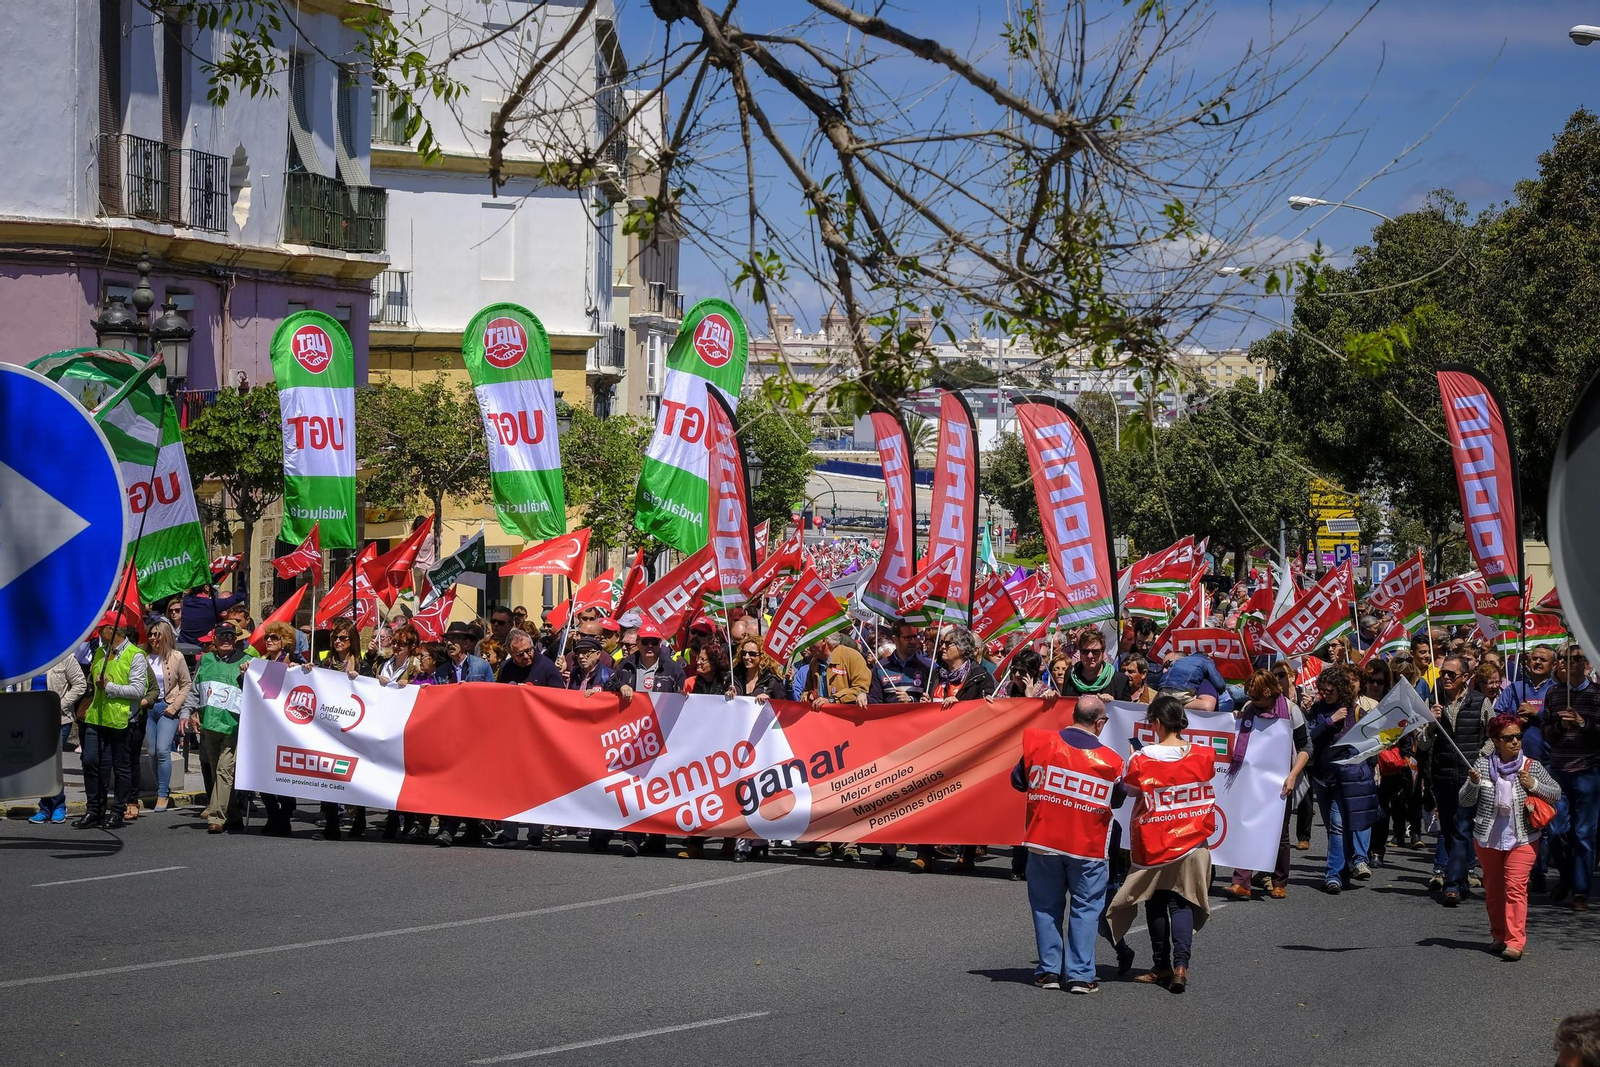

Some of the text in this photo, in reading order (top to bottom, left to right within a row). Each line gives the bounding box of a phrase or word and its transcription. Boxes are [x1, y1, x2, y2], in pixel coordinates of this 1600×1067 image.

[1336, 545, 1348, 562] P
[1379, 563, 1389, 581] P
[291, 691, 315, 709] UGT
[320, 703, 356, 718] Andalucía
[600, 715, 653, 748] mayo
[279, 750, 332, 774] CCOO
[605, 732, 660, 773] 2018
[275, 776, 291, 784] unión
[292, 778, 320, 789] provincial
[329, 781, 346, 791] Cádiz
[605, 740, 757, 818] Tiempo
[675, 740, 850, 832] de ganar
[830, 763, 878, 792] Igualdad
[840, 765, 914, 804] Mejor empleo
[1049, 771, 1110, 801] CCOO
[853, 770, 945, 817] Mayores salarios
[869, 781, 963, 829] Pensiones dignas
[1062, 798, 1073, 808] de
[1177, 811, 1188, 819] de
